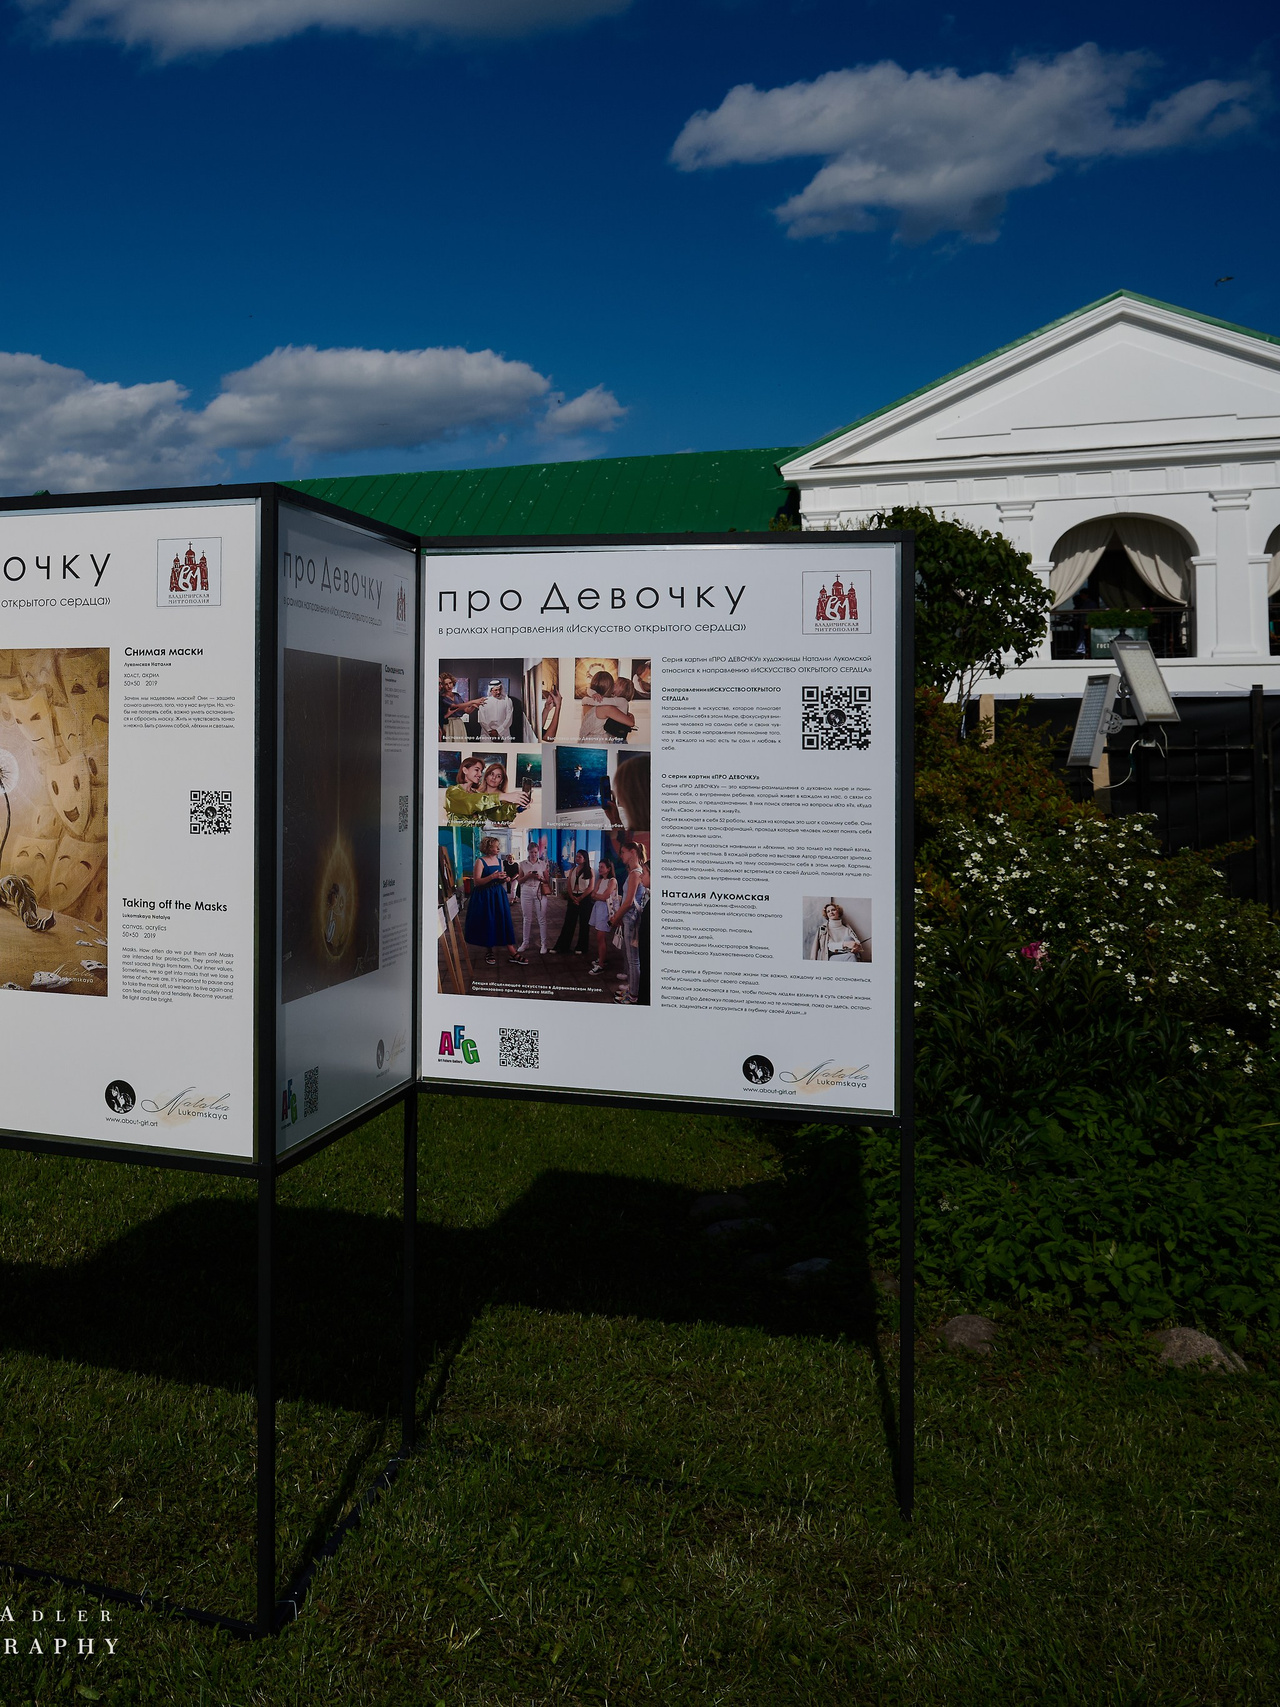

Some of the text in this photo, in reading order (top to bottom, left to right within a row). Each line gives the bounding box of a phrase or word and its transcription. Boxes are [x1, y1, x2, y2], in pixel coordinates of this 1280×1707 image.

[283, 552, 382, 609] про Девочку
[1, 599, 57, 609] открытого
[60, 597, 110, 608] сердца»
[439, 583, 745, 618] про Девочку
[447, 627, 488, 636] рамках
[491, 626, 563, 635] направления
[566, 625, 631, 634] «Искусство
[634, 625, 691, 634] открытого
[695, 624, 746, 633] сердца»
[125, 647, 165, 656] Снимая
[662, 890, 769, 901] Наталия Лукомская
[122, 898, 227, 911] Taking off the Masks
[438, 1025, 480, 1064] AFG
[779, 1060, 869, 1085] Natalia
[817, 1079, 866, 1088] Lukomskaya
[141, 1087, 230, 1115] Natalia
[178, 1109, 227, 1120] Lukomskaya
[106, 1117, 158, 1126] www.about-girl.art
